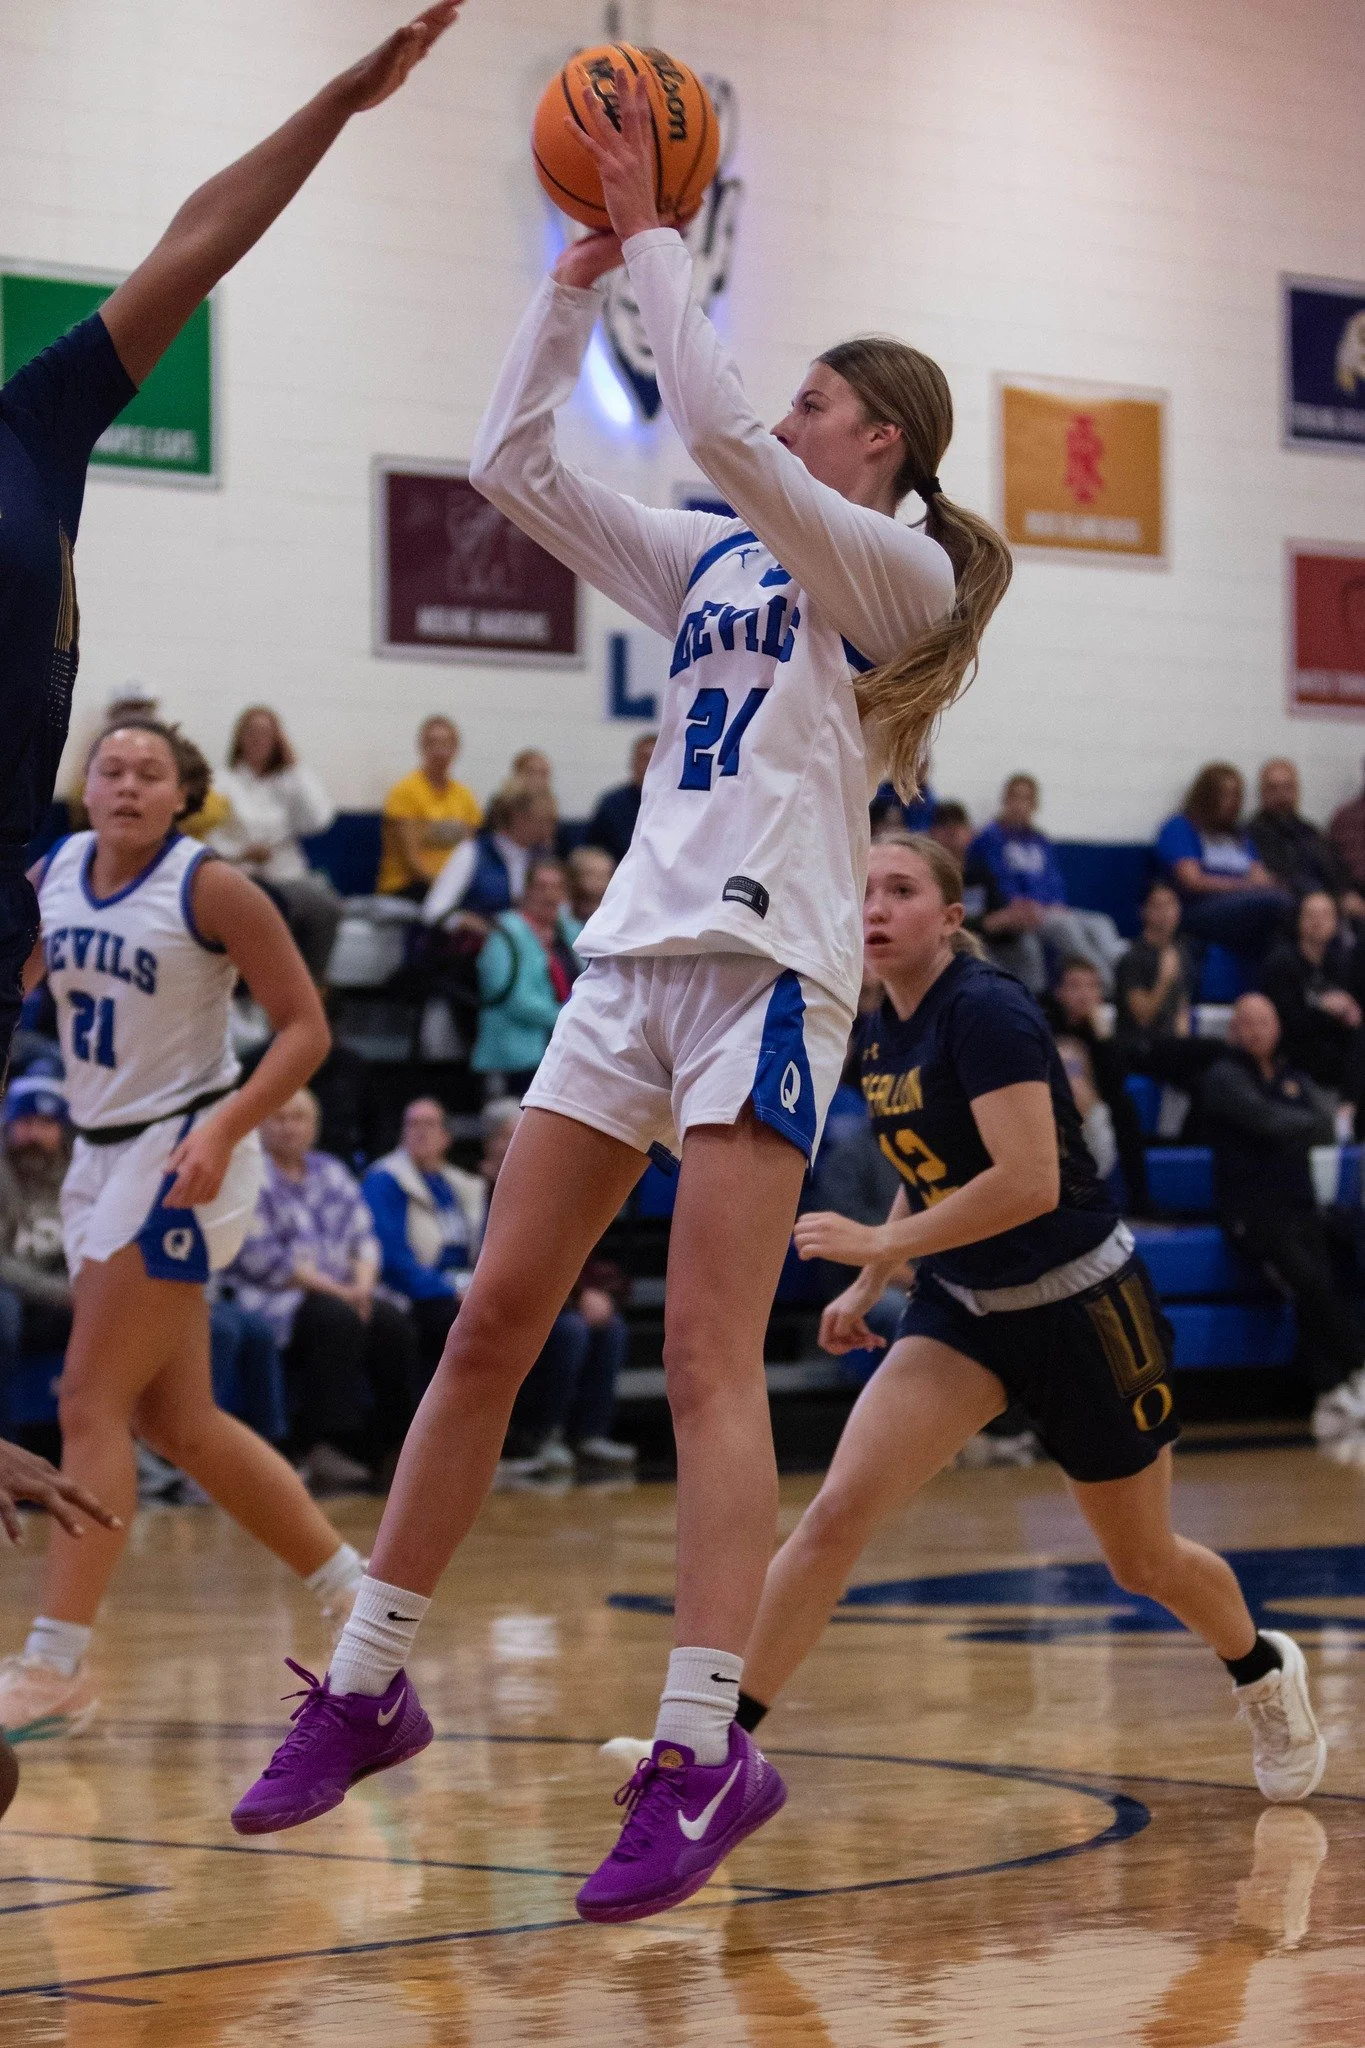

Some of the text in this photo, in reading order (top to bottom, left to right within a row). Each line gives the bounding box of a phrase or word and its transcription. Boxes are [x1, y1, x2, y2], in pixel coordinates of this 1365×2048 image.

[46, 926, 158, 995] EVILS
[67, 990, 116, 1069] 21
[780, 1060, 802, 1114] Q
